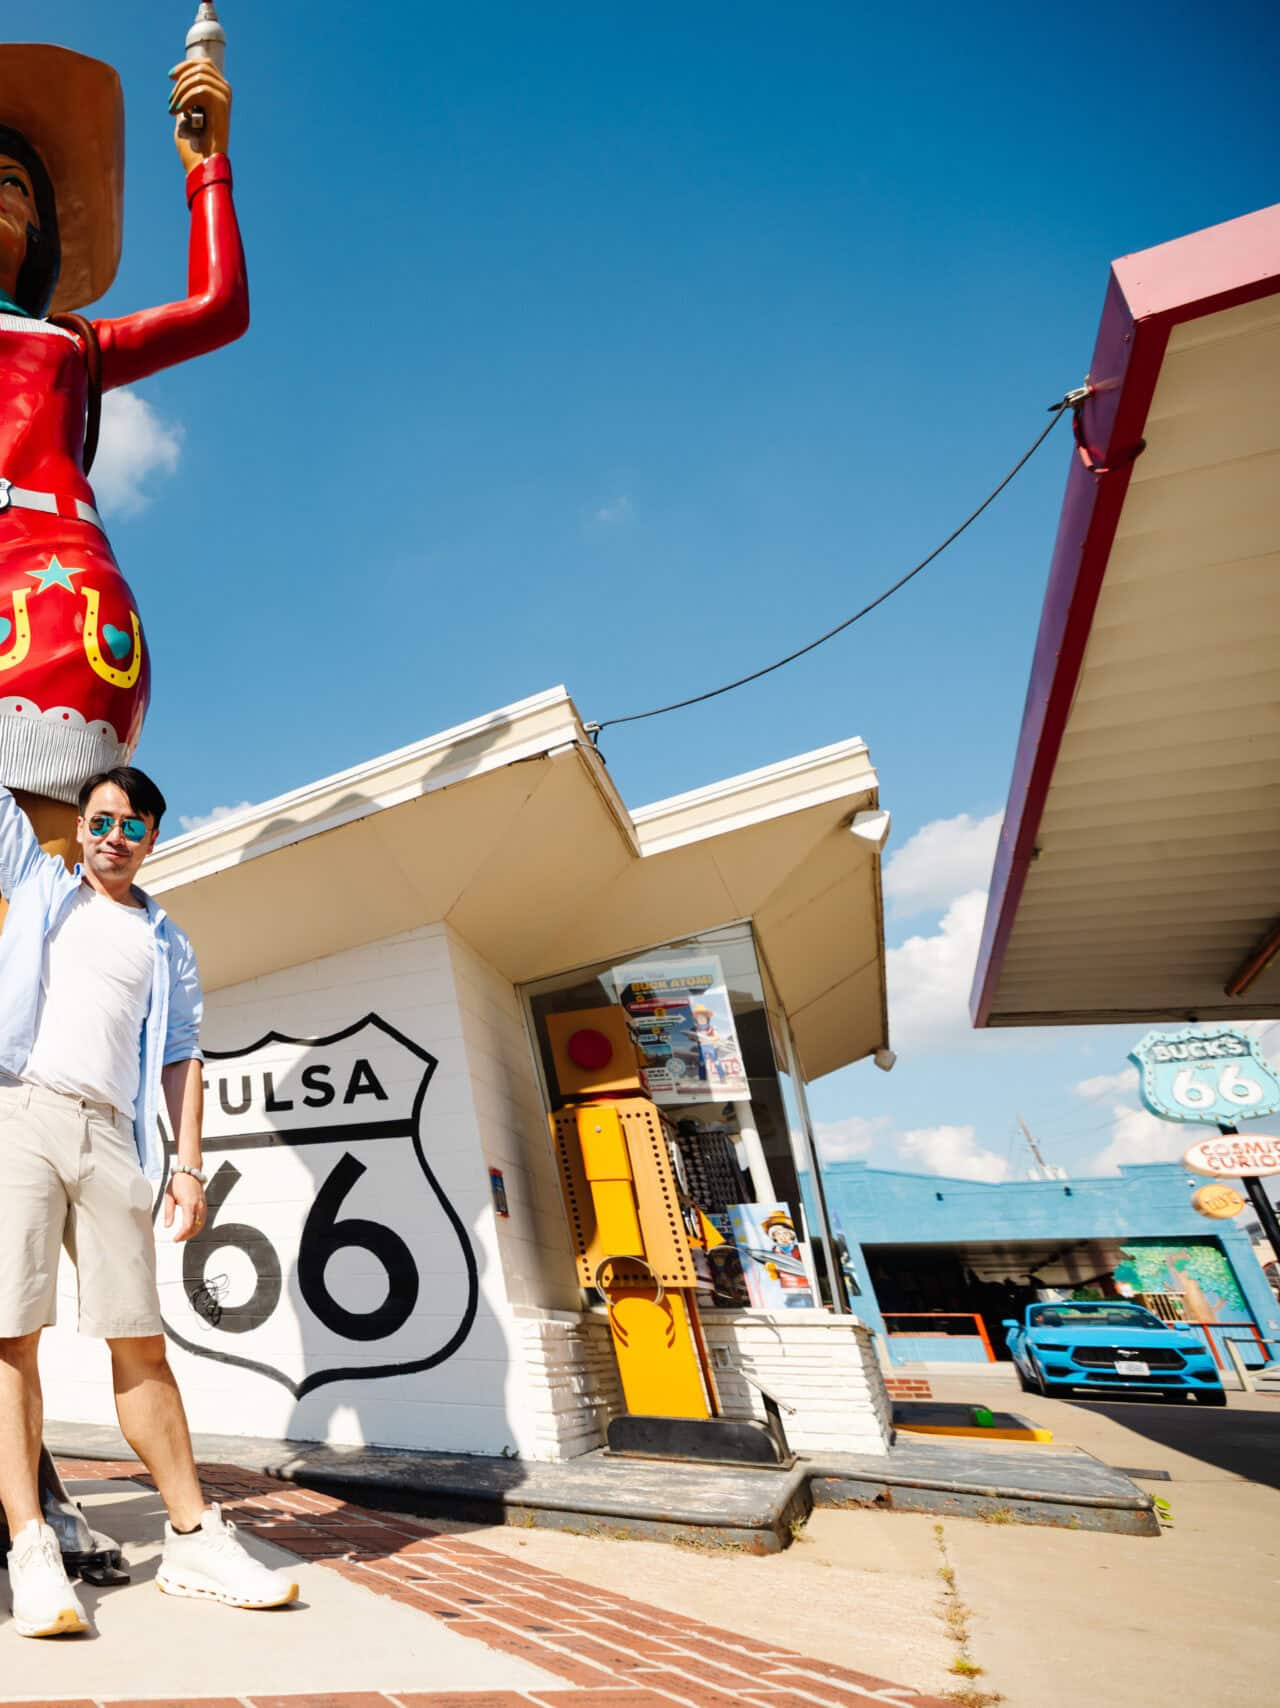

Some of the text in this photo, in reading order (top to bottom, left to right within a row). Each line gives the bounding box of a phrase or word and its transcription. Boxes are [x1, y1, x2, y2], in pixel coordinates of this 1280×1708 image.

[203, 1059, 388, 1115] ULSA
[1172, 1064, 1264, 1109] 66
[1207, 1154, 1280, 1169] CURIO
[182, 1151, 419, 1342] 66
